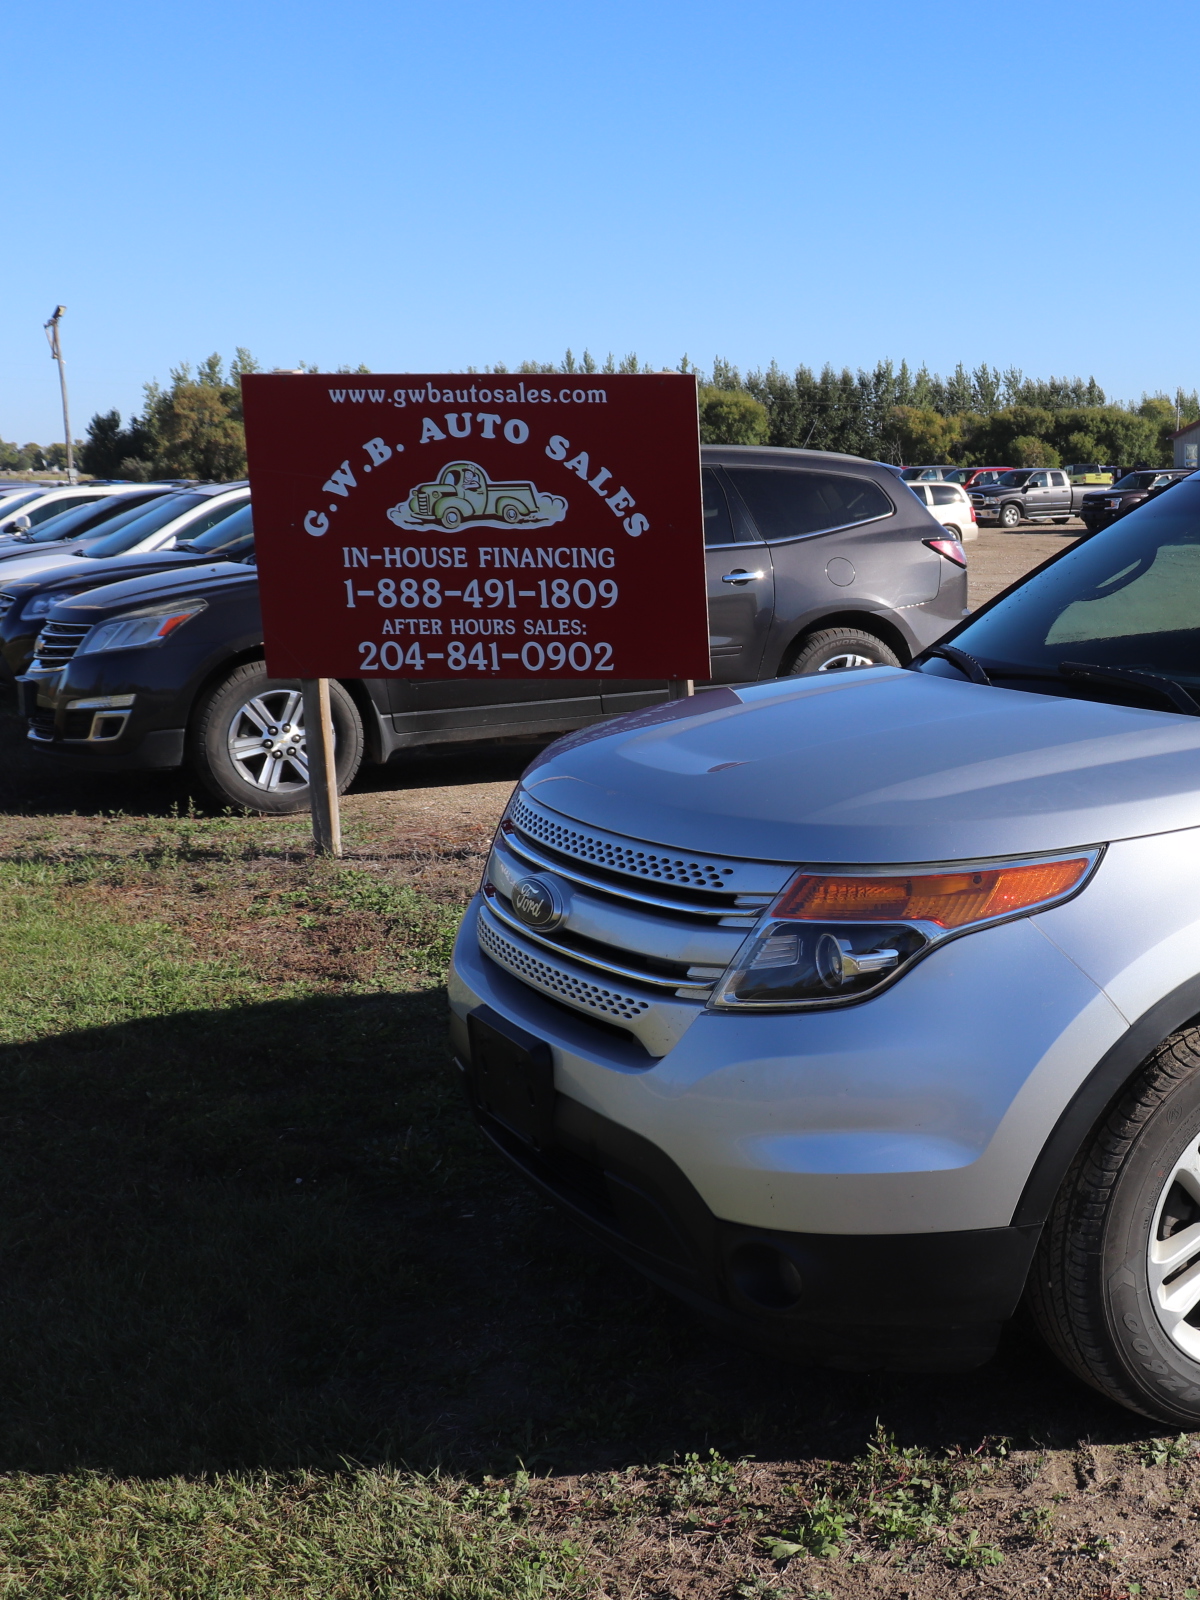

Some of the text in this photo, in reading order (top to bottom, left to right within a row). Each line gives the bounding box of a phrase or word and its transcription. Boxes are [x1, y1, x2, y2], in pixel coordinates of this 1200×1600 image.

[328, 381, 608, 408] www.gwbautosales.com
[303, 412, 650, 538] G.W.B. AUTO SALES
[342, 546, 615, 569] IN-HOUSE FINANCING
[343, 578, 619, 609] 1-888-491-1809
[381, 618, 587, 636] AFTER HOURS SALES:
[358, 640, 615, 671] 204-841-0902
[516, 883, 545, 918] Ford
